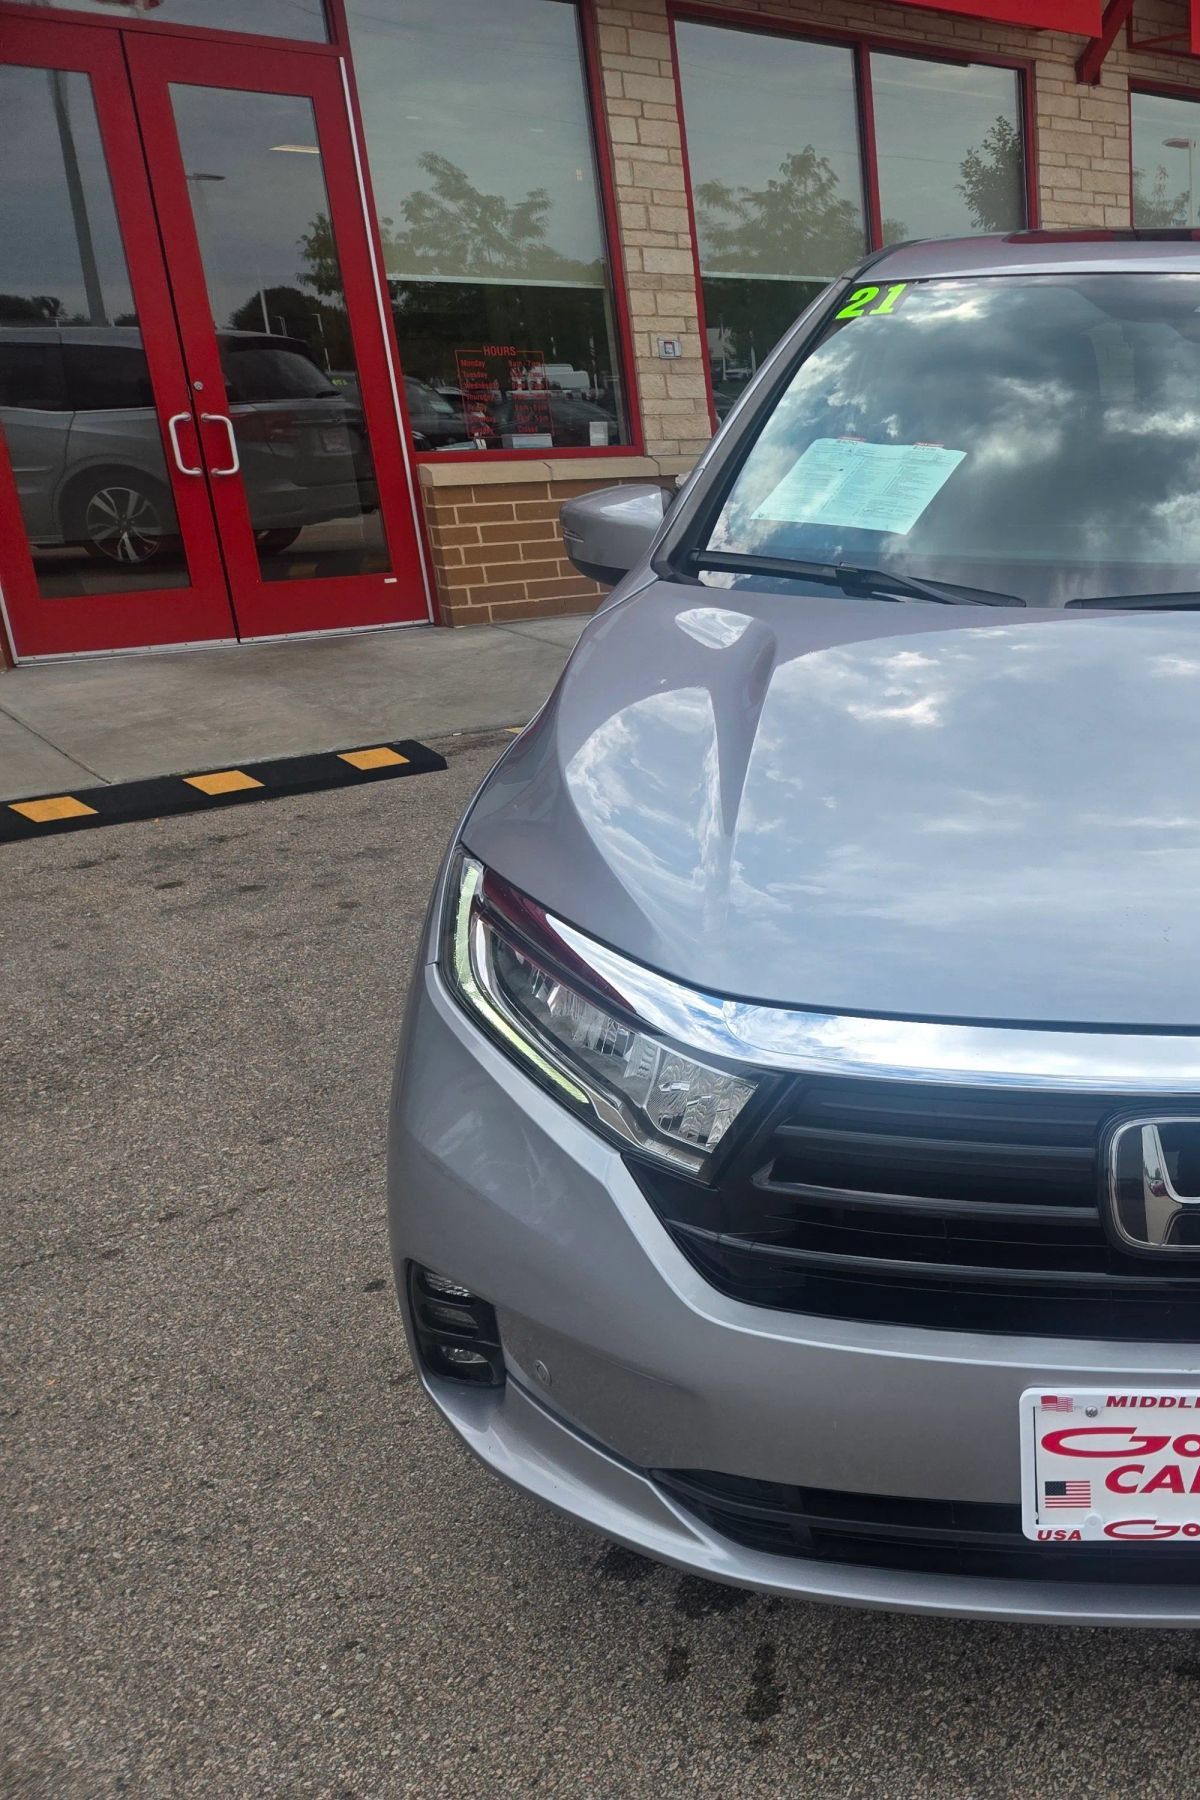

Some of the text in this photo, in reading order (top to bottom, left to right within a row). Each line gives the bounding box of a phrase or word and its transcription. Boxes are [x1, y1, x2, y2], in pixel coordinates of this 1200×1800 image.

[835, 283, 907, 319] 21
[483, 345, 517, 356] HOURS
[460, 359, 485, 368] Monday
[462, 371, 488, 379] Tuesday
[1037, 1529, 1082, 1541] USA
